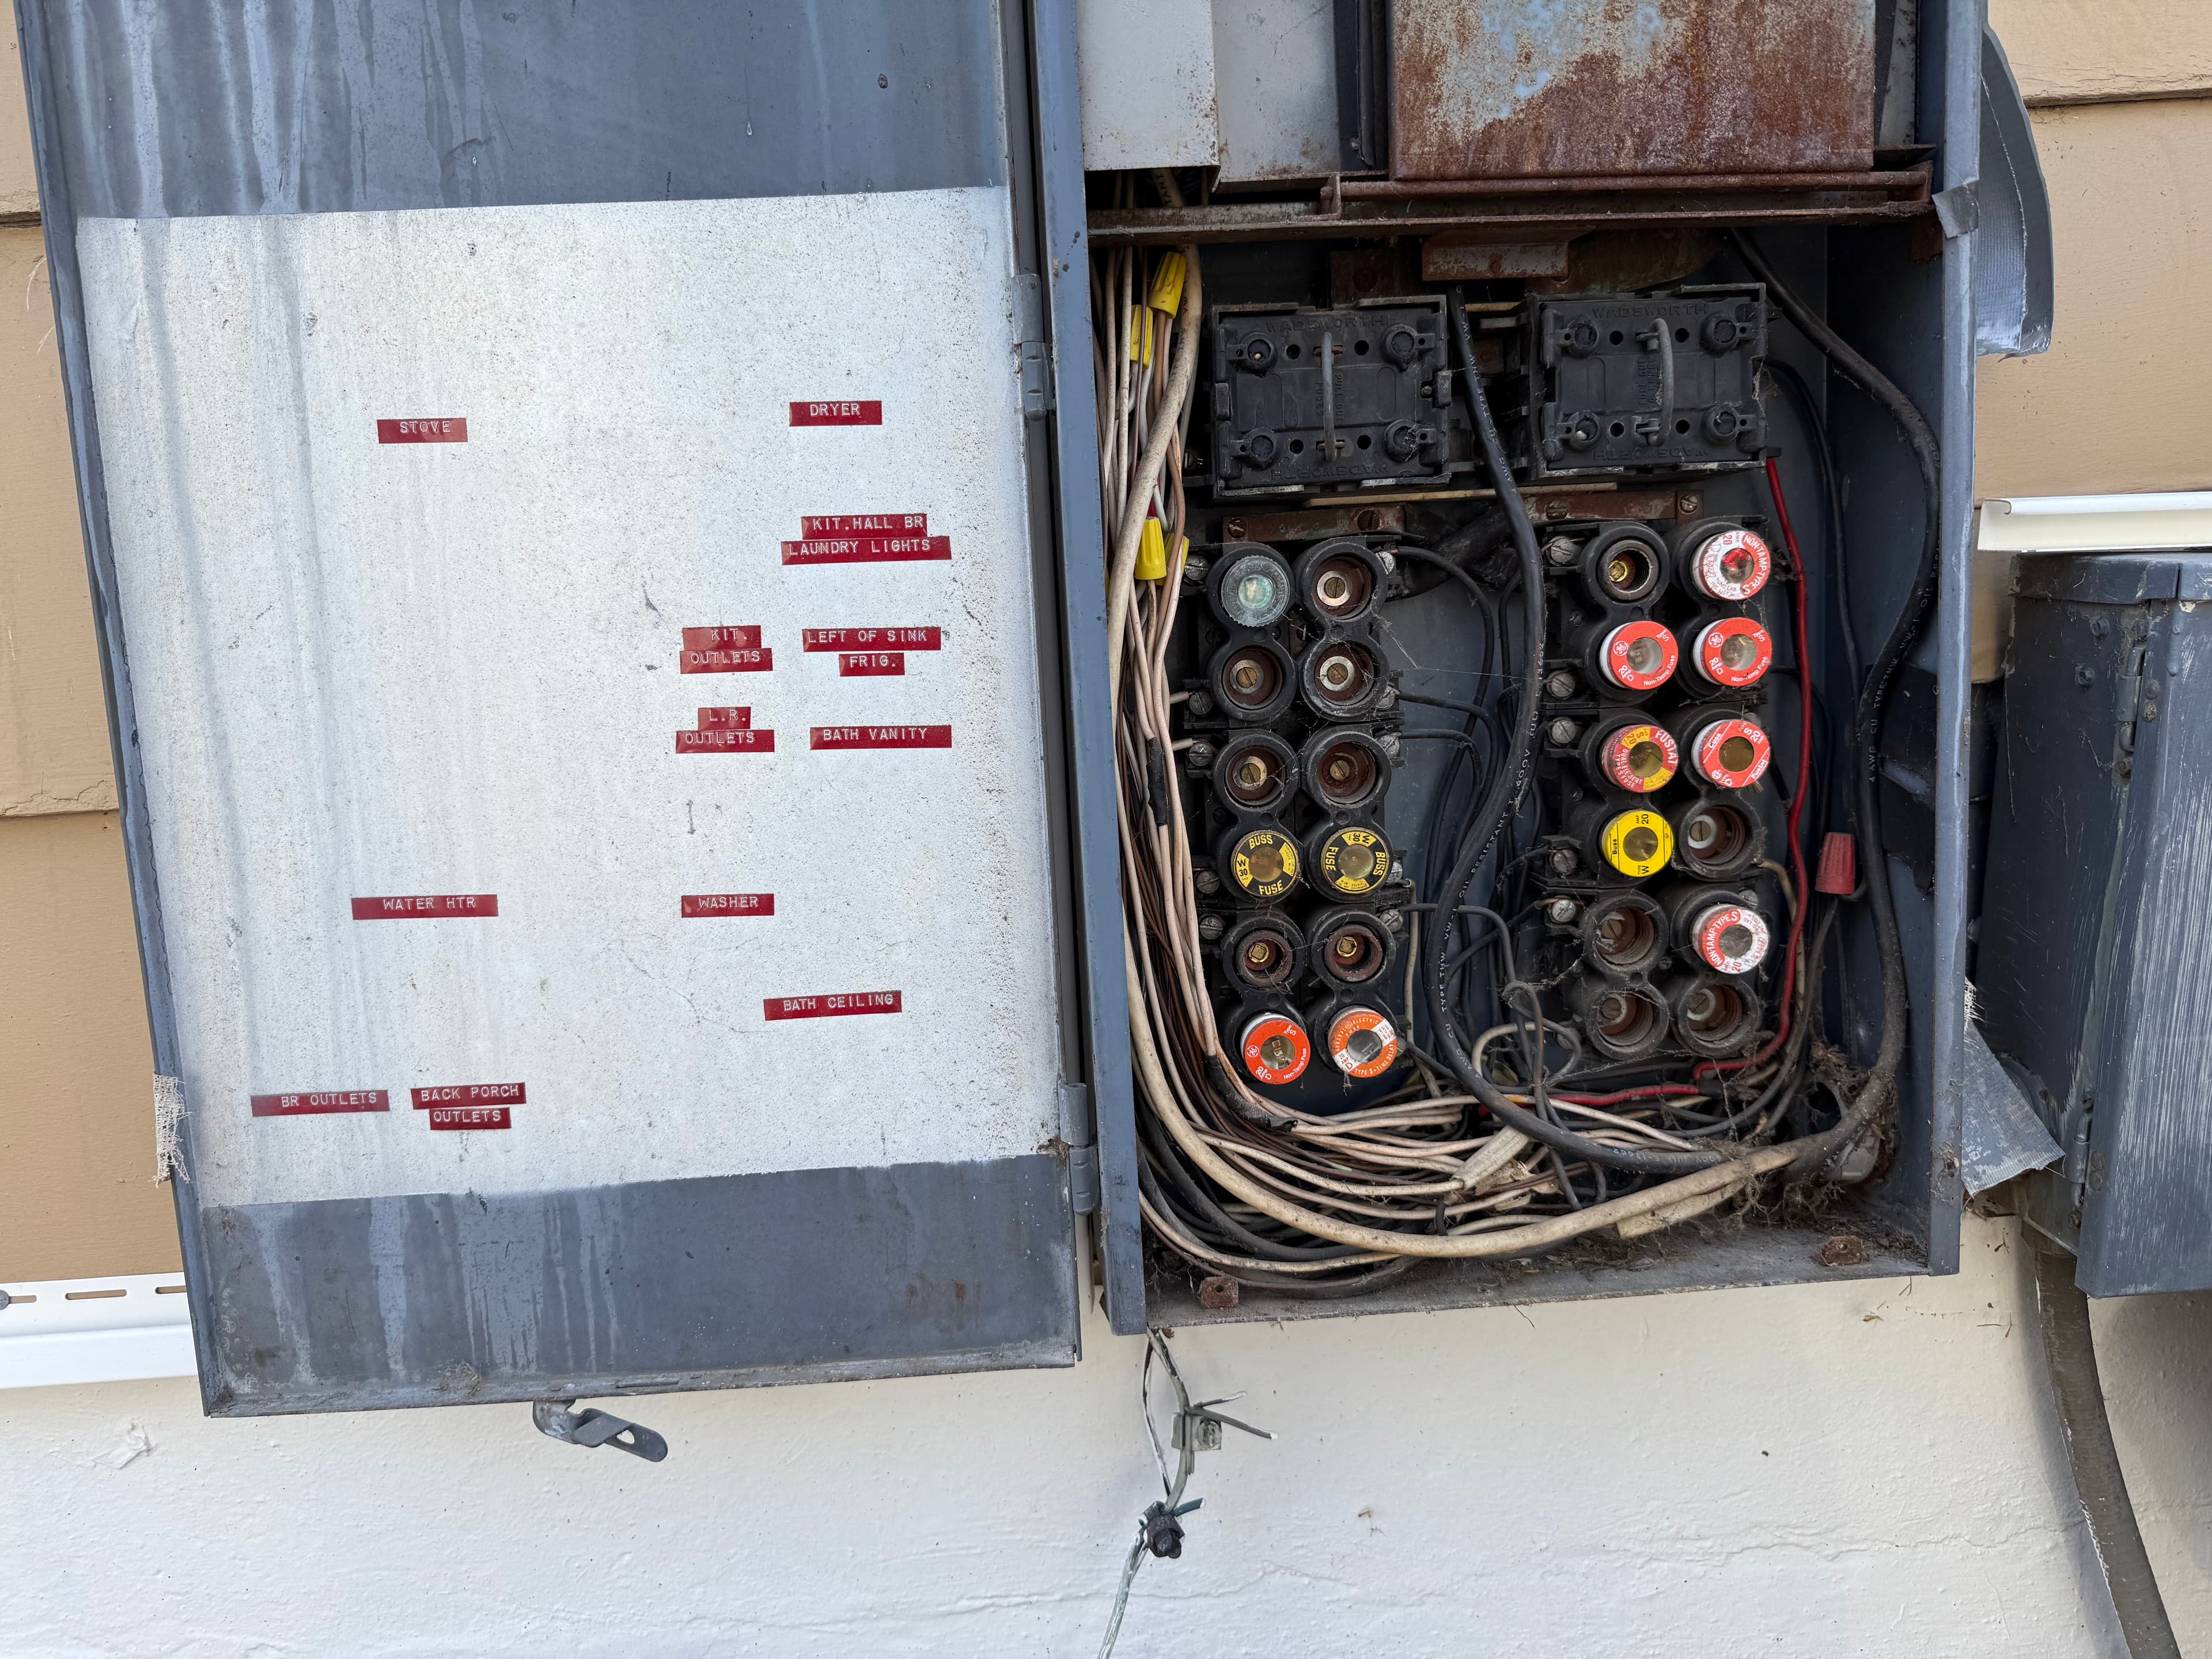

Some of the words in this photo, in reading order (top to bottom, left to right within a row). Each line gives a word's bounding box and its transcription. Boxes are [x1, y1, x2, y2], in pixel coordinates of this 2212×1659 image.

[1592, 304, 1708, 318] WADSWORTH
[1266, 314, 1386, 332] WADSWORTH
[1459, 305, 1471, 341] VW-1
[1469, 354, 1480, 381] THW
[1638, 359, 1646, 377] OUT
[1335, 374, 1343, 399] PULL
[810, 403, 861, 416] DRYER
[1476, 388, 1490, 418] TYPE
[400, 421, 451, 434] STOVE
[1271, 463, 1389, 479] WADSWORTH
[904, 516, 924, 529] BR
[788, 540, 859, 556] LAUNDRY
[870, 539, 931, 553] LIGHTS
[1723, 535, 1733, 546] 20
[1743, 584, 1751, 594] S
[1921, 588, 1933, 608] OIL
[711, 628, 747, 641] KIT.
[807, 630, 846, 643] LEFT
[858, 630, 877, 642] OF
[887, 630, 927, 642] SINK
[691, 650, 760, 664] OUTLETS
[850, 655, 896, 668] FRIG.
[1710, 657, 1719, 666] 20
[1757, 656, 1768, 670] Fuse
[1619, 665, 1628, 675] 20
[1643, 670, 1669, 685] Non-Tamp
[1666, 655, 1675, 669] Fuse
[1717, 667, 1723, 675] D
[1883, 658, 1899, 680] THW
[709, 710, 747, 721] L.R.
[1744, 728, 1752, 736] S
[1870, 719, 1877, 734] CU
[685, 732, 755, 744] OUTLETS
[823, 728, 859, 741] BATH
[868, 728, 927, 740] VANITY
[1626, 733, 1637, 745] 20
[1750, 730, 1760, 743] 20
[1654, 729, 1678, 766] FUSTAT
[1868, 746, 1877, 771] AWG
[1515, 749, 1531, 787] 600V
[1751, 759, 1767, 779] Fustat
[1620, 776, 1636, 788] FUSE
[1641, 813, 1649, 825] 20
[1248, 834, 1273, 850] BUSS
[1353, 833, 1361, 842] 30
[1362, 835, 1370, 844] W
[1471, 812, 1509, 873] RESISTANT
[1237, 859, 1246, 868] W
[1325, 847, 1339, 871] FUSE
[1373, 851, 1387, 876] BUSS
[1642, 865, 1650, 874] W
[1258, 880, 1283, 895] FUSE
[1458, 879, 1471, 899] OIL
[382, 897, 434, 910] WATER
[446, 897, 476, 908] HTR
[698, 896, 759, 908] WASHER
[1731, 911, 1738, 921] S
[1439, 952, 1447, 978] THW
[1731, 961, 1742, 972] 20
[783, 998, 816, 1011] BATH
[828, 994, 893, 1008] CEILING
[1439, 983, 1447, 1013] TYPE
[1445, 1023, 1454, 1038] CU
[1376, 1059, 1389, 1071] TIME
[1386, 1044, 1394, 1060] DELAY
[1256, 1066, 1264, 1075] 20
[1283, 1061, 1304, 1080] Non-Tamp
[281, 1096, 300, 1107] BR
[310, 1092, 377, 1105] OUTLETS
[421, 1088, 461, 1101] BACK
[471, 1085, 519, 1098] PORCH
[433, 1111, 501, 1122] OUTLETS
